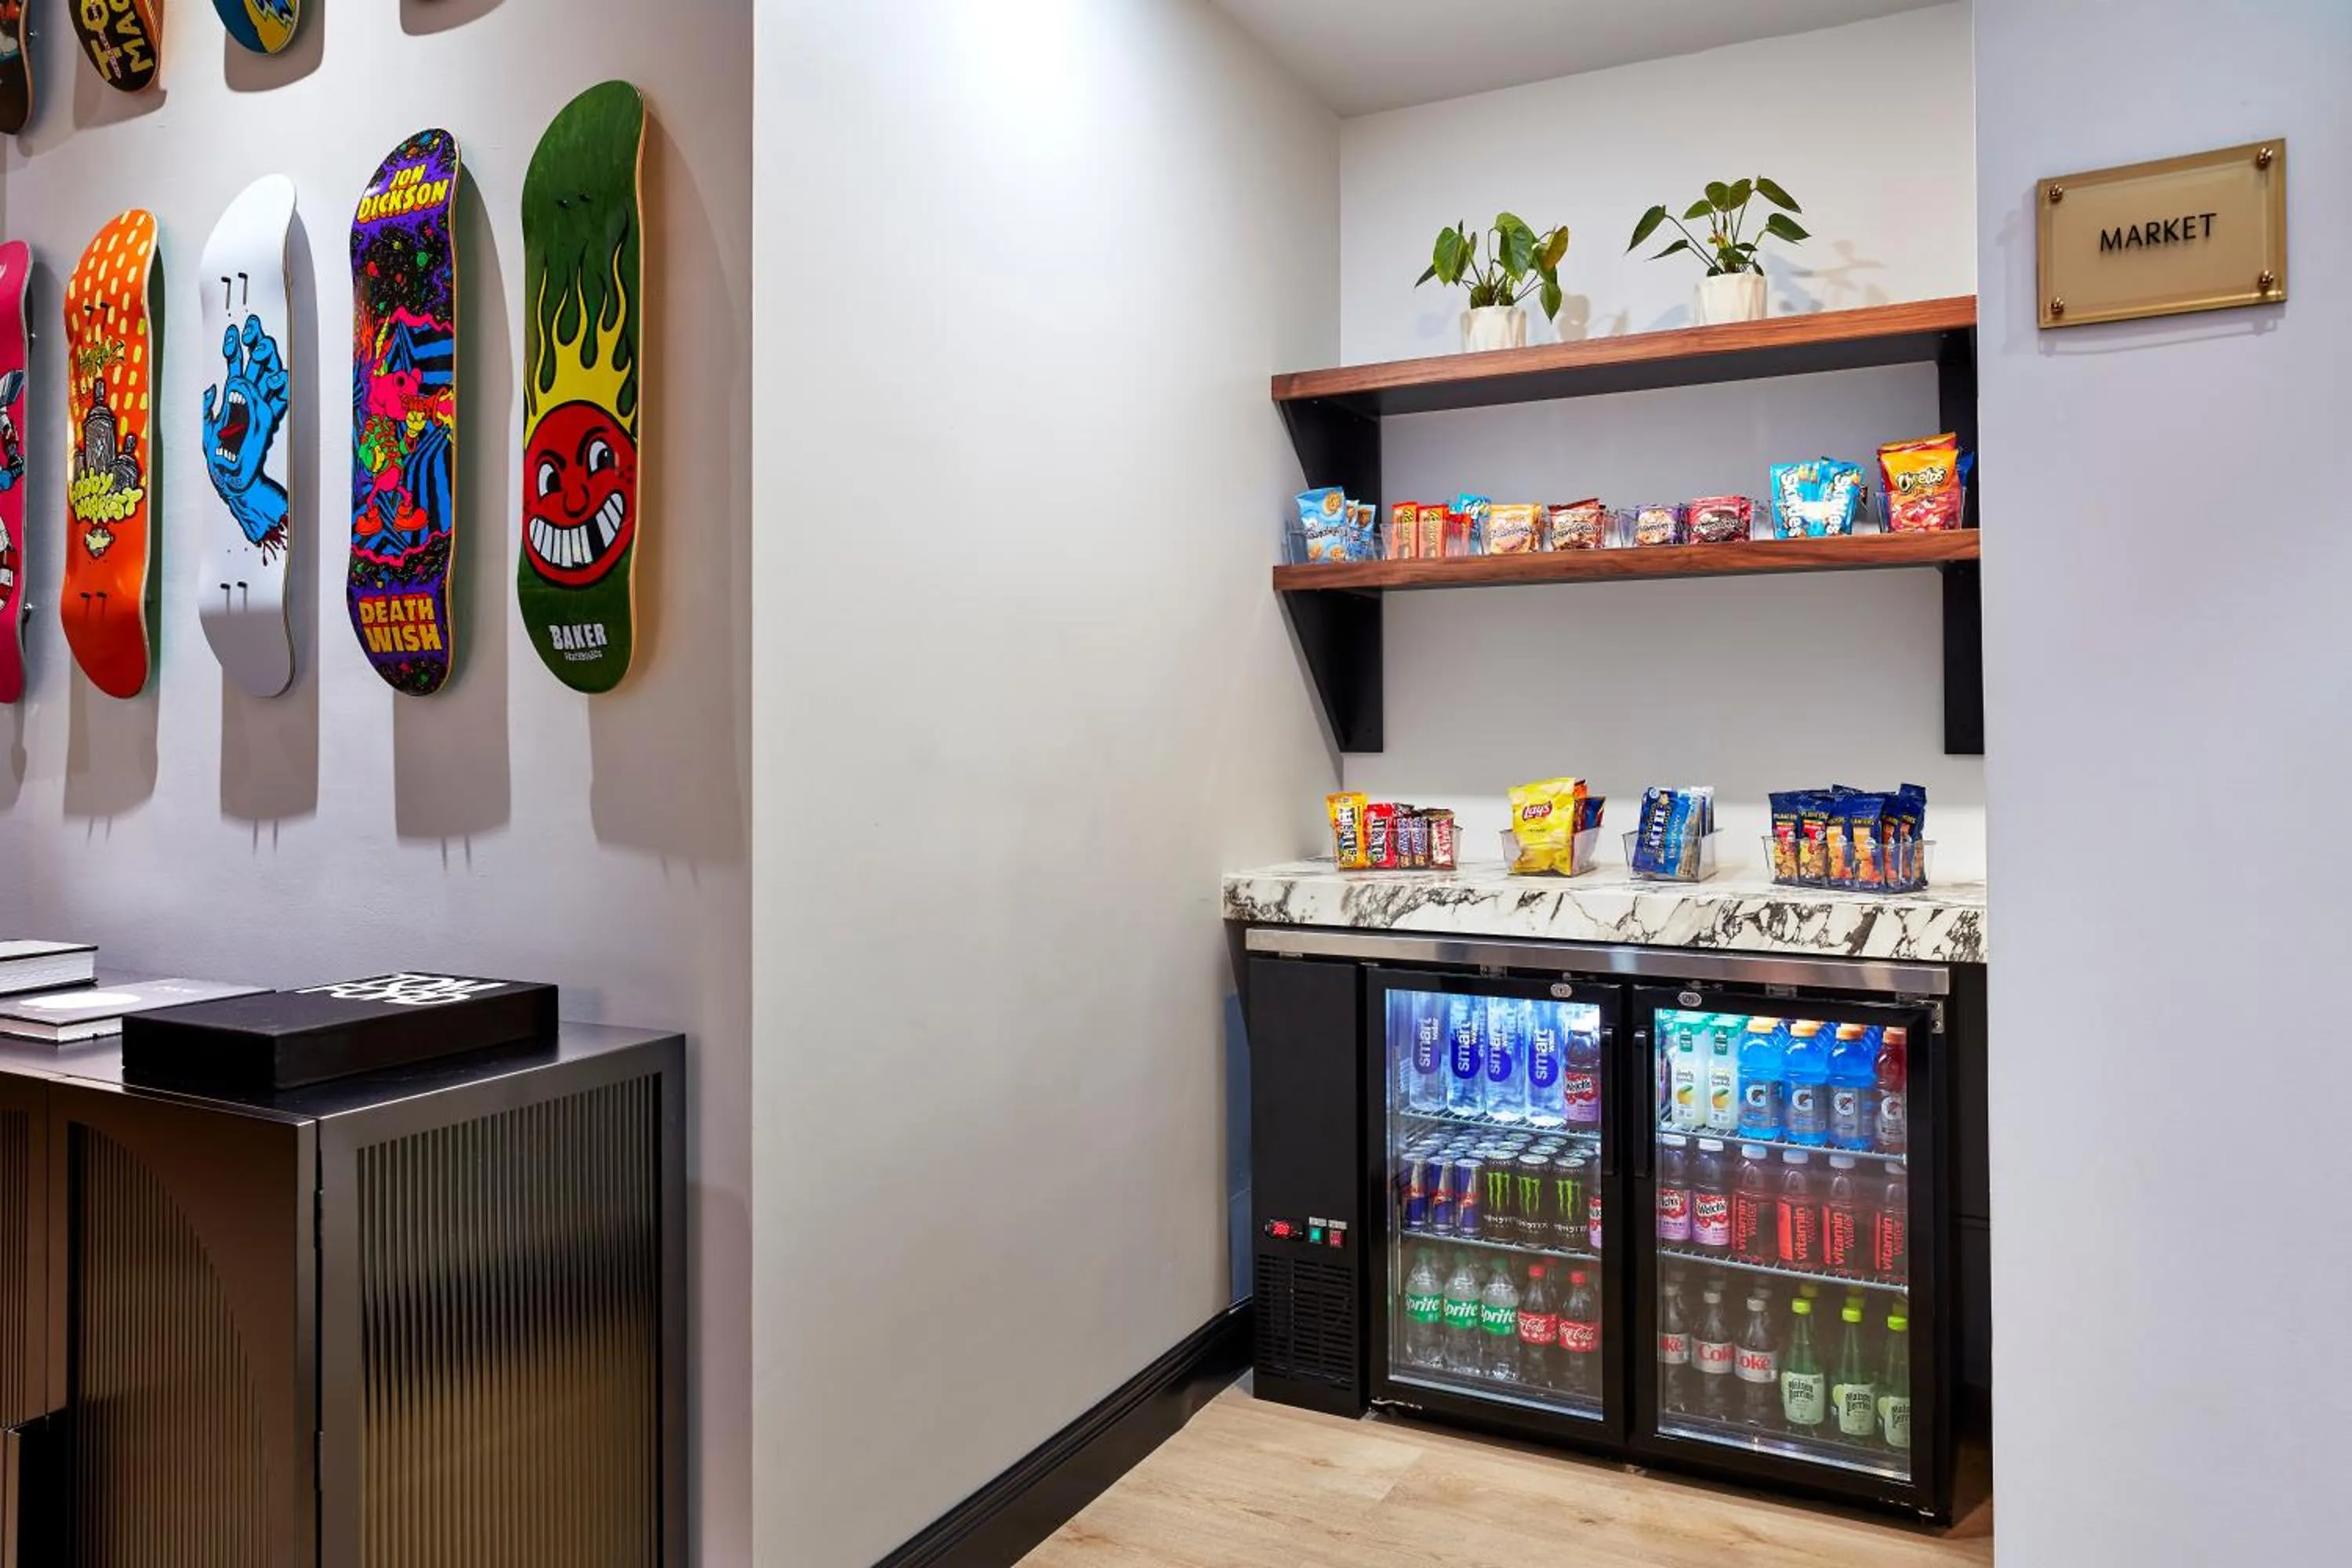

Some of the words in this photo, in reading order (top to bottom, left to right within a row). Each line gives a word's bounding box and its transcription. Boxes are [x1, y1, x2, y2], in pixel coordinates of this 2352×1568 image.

[389, 163, 427, 190] JON
[357, 179, 449, 223] DICKSON
[2100, 212, 2218, 252] MARKET
[1897, 466, 1947, 493] Cheetos
[358, 593, 436, 624] DEATH
[362, 624, 443, 653] WISH
[548, 622, 608, 650] BAKER
[1523, 802, 1552, 821] Lay's
[1417, 1017, 1432, 1067] smart
[1457, 1018, 1470, 1073] smart
[1534, 1028, 1548, 1080] smart
[1745, 1084, 1766, 1107] G
[1792, 1089, 1813, 1111] G
[1834, 1091, 1855, 1115] G
[1882, 1097, 1903, 1120] G
[1699, 1202, 1726, 1214] Welch's
